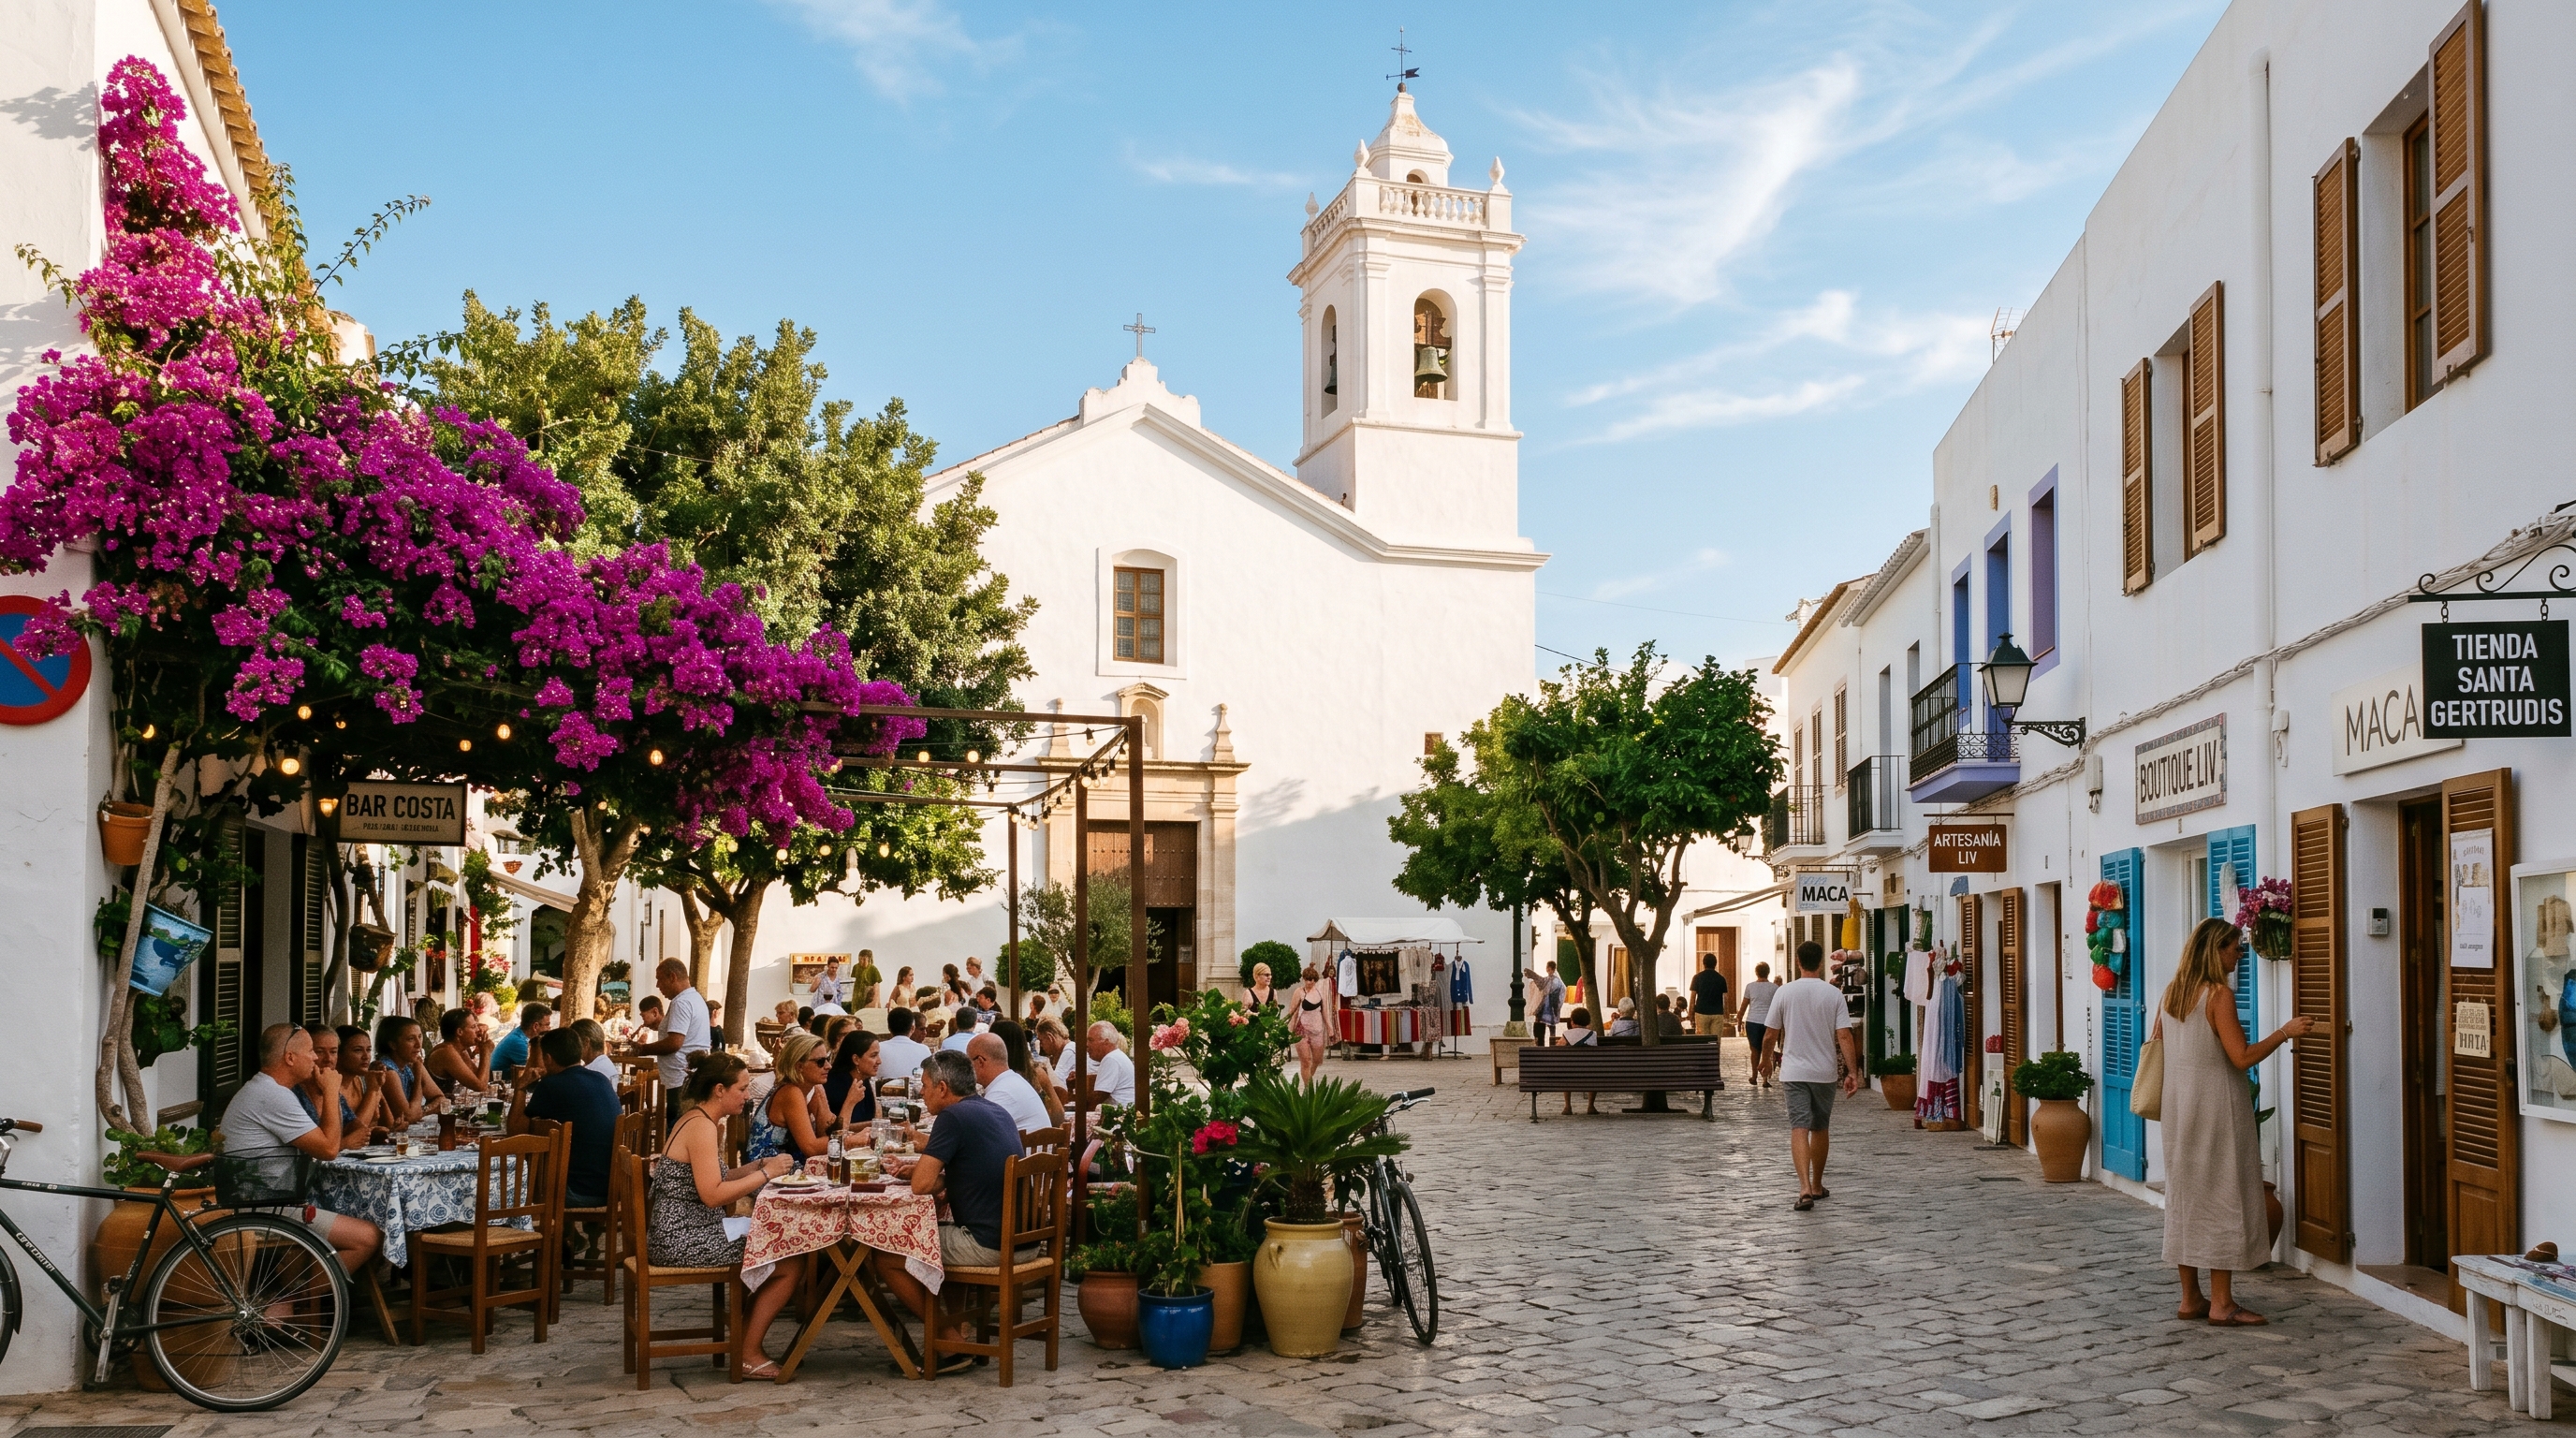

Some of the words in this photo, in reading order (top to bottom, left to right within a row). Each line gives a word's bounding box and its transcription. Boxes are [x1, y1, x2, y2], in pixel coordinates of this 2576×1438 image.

[2452, 633, 2539, 660] TIENDA
[2457, 666, 2535, 693] SANTA
[2346, 683, 2421, 756] MACA
[2431, 698, 2563, 726] GERTRUDIS
[2140, 748, 2194, 803] BOUTIQUE
[2197, 740, 2217, 787] LIV
[346, 793, 387, 817] BAR
[393, 795, 456, 820] COSTA
[1934, 829, 2001, 847] ARTESANÍA
[1958, 851, 1977, 864] LIV
[1802, 886, 1850, 902] MACA
